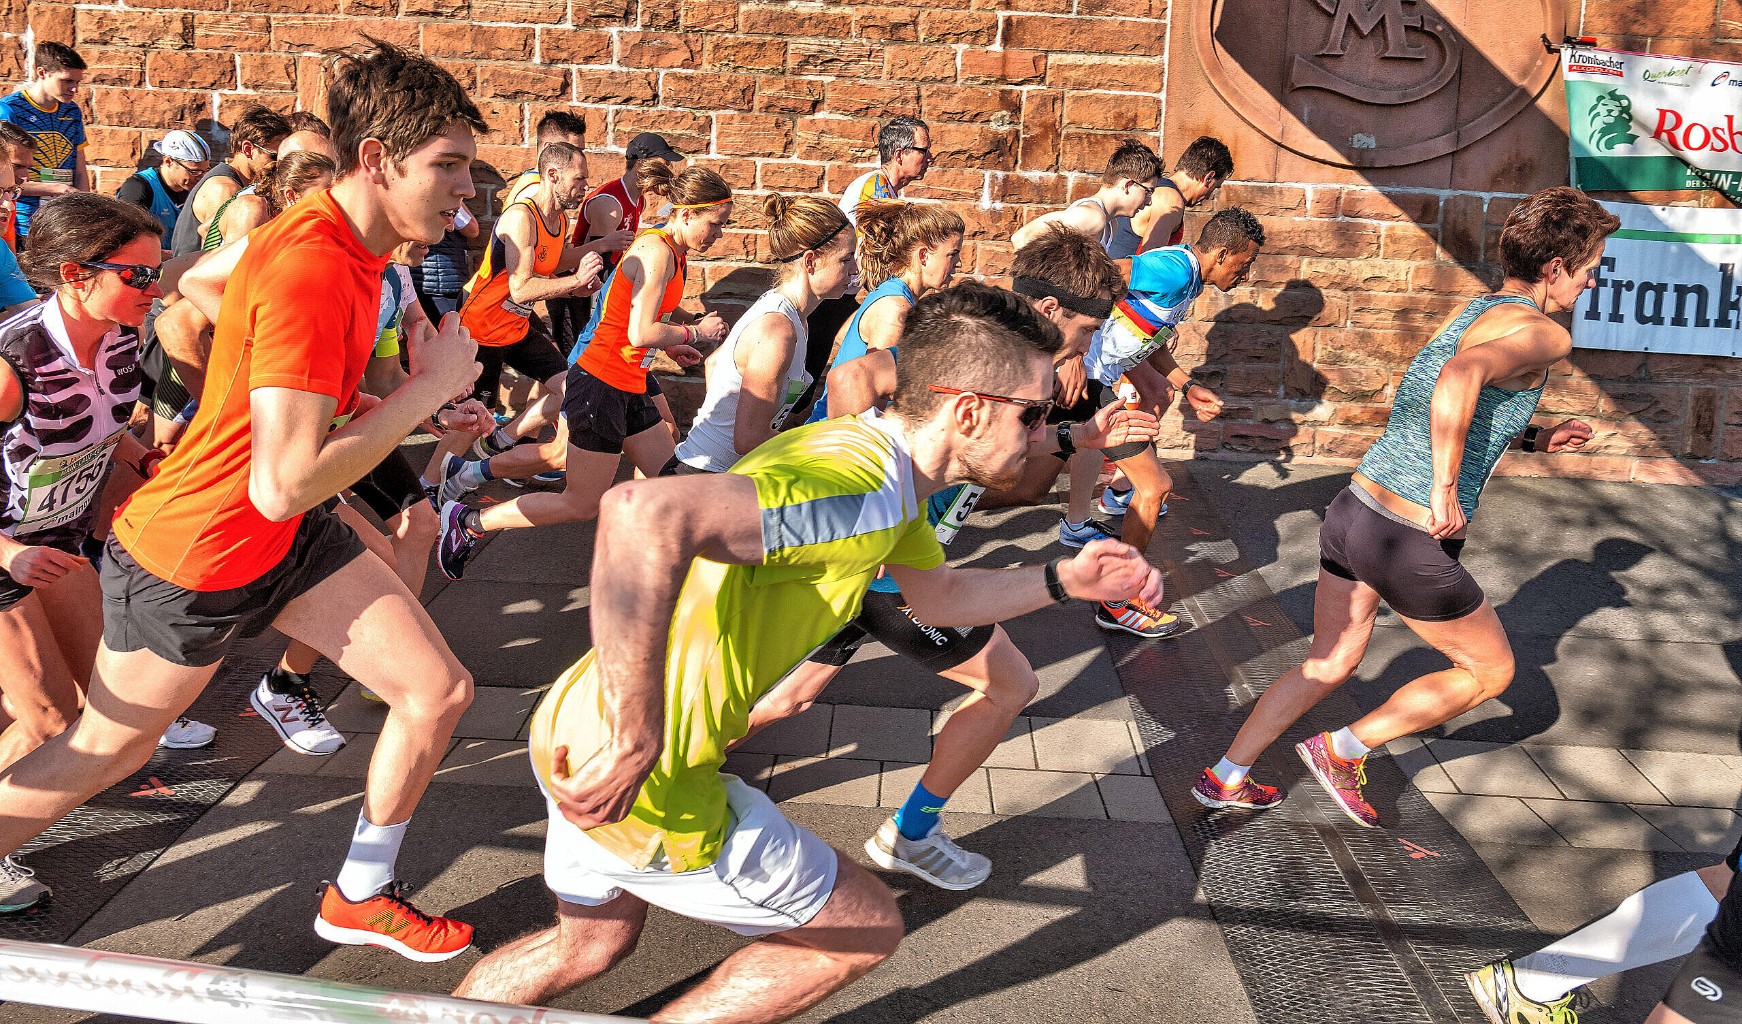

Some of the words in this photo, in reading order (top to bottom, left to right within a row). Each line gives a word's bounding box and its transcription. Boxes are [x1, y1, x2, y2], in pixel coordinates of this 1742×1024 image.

[1569, 49, 1625, 70] Krombacher
[1642, 64, 1694, 83] Querbeet
[1584, 256, 1742, 330] frank
[37, 453, 106, 513] 4756
